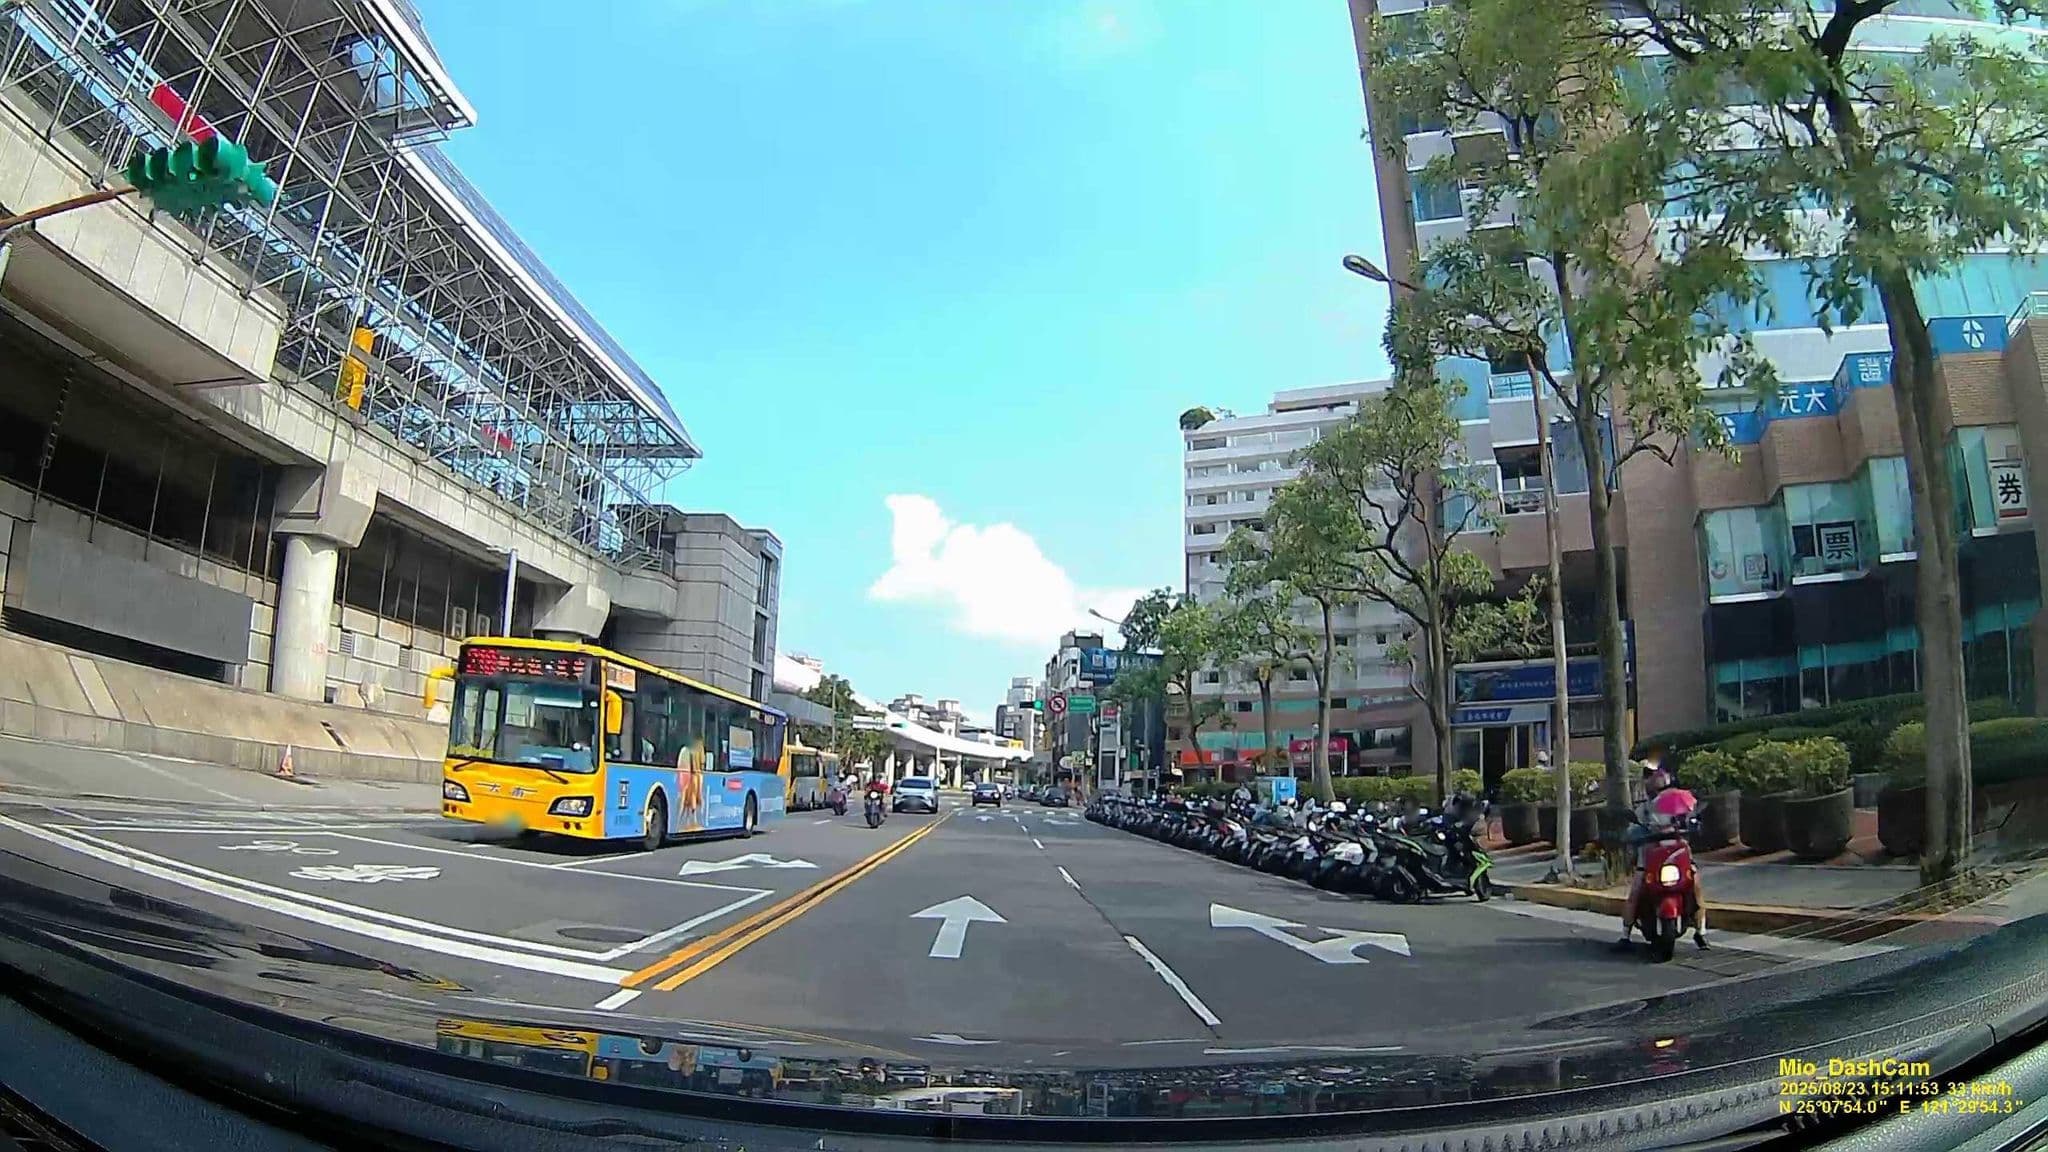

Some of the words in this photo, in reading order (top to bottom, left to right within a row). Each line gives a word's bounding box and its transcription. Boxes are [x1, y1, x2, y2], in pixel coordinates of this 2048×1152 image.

[1778, 384, 1827, 414] 元大
[1858, 357, 1892, 382] 證
[1825, 532, 1853, 560] 票
[1998, 473, 2021, 504] 券
